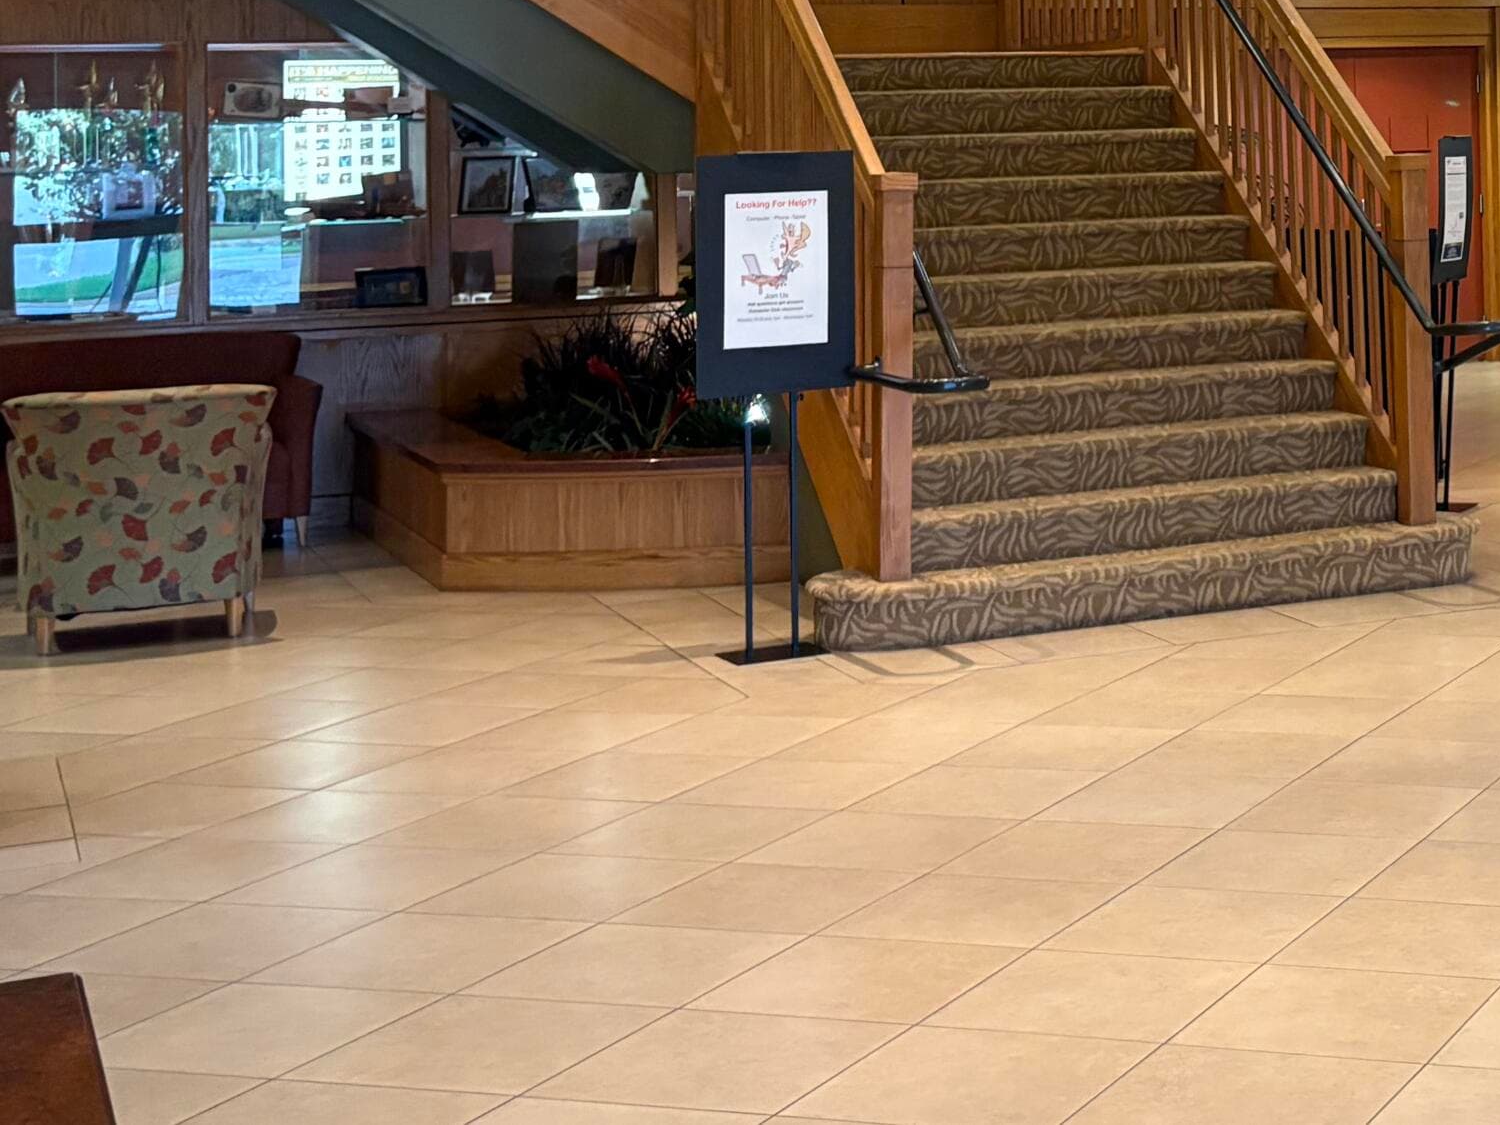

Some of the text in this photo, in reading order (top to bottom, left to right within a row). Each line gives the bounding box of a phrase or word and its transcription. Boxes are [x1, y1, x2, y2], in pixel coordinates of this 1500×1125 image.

[736, 198, 817, 210] Looking For Help??
